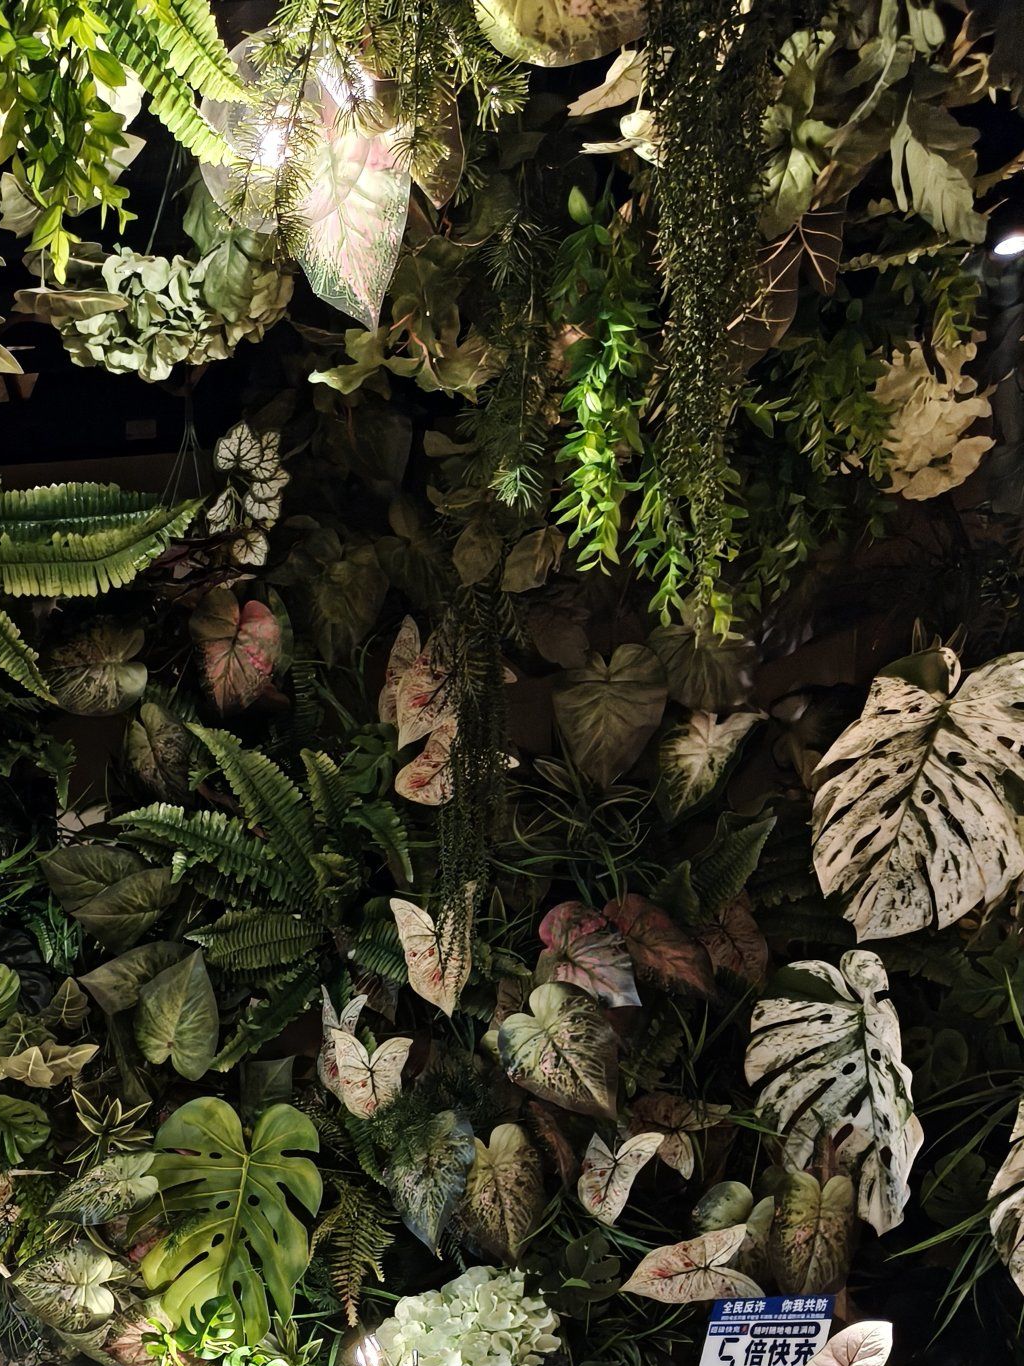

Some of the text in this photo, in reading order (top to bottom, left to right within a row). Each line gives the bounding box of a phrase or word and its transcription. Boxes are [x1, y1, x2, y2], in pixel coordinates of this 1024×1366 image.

[723, 1299, 828, 1313] 全民反诈 你我共防
[744, 1339, 816, 1366] 倍快充
